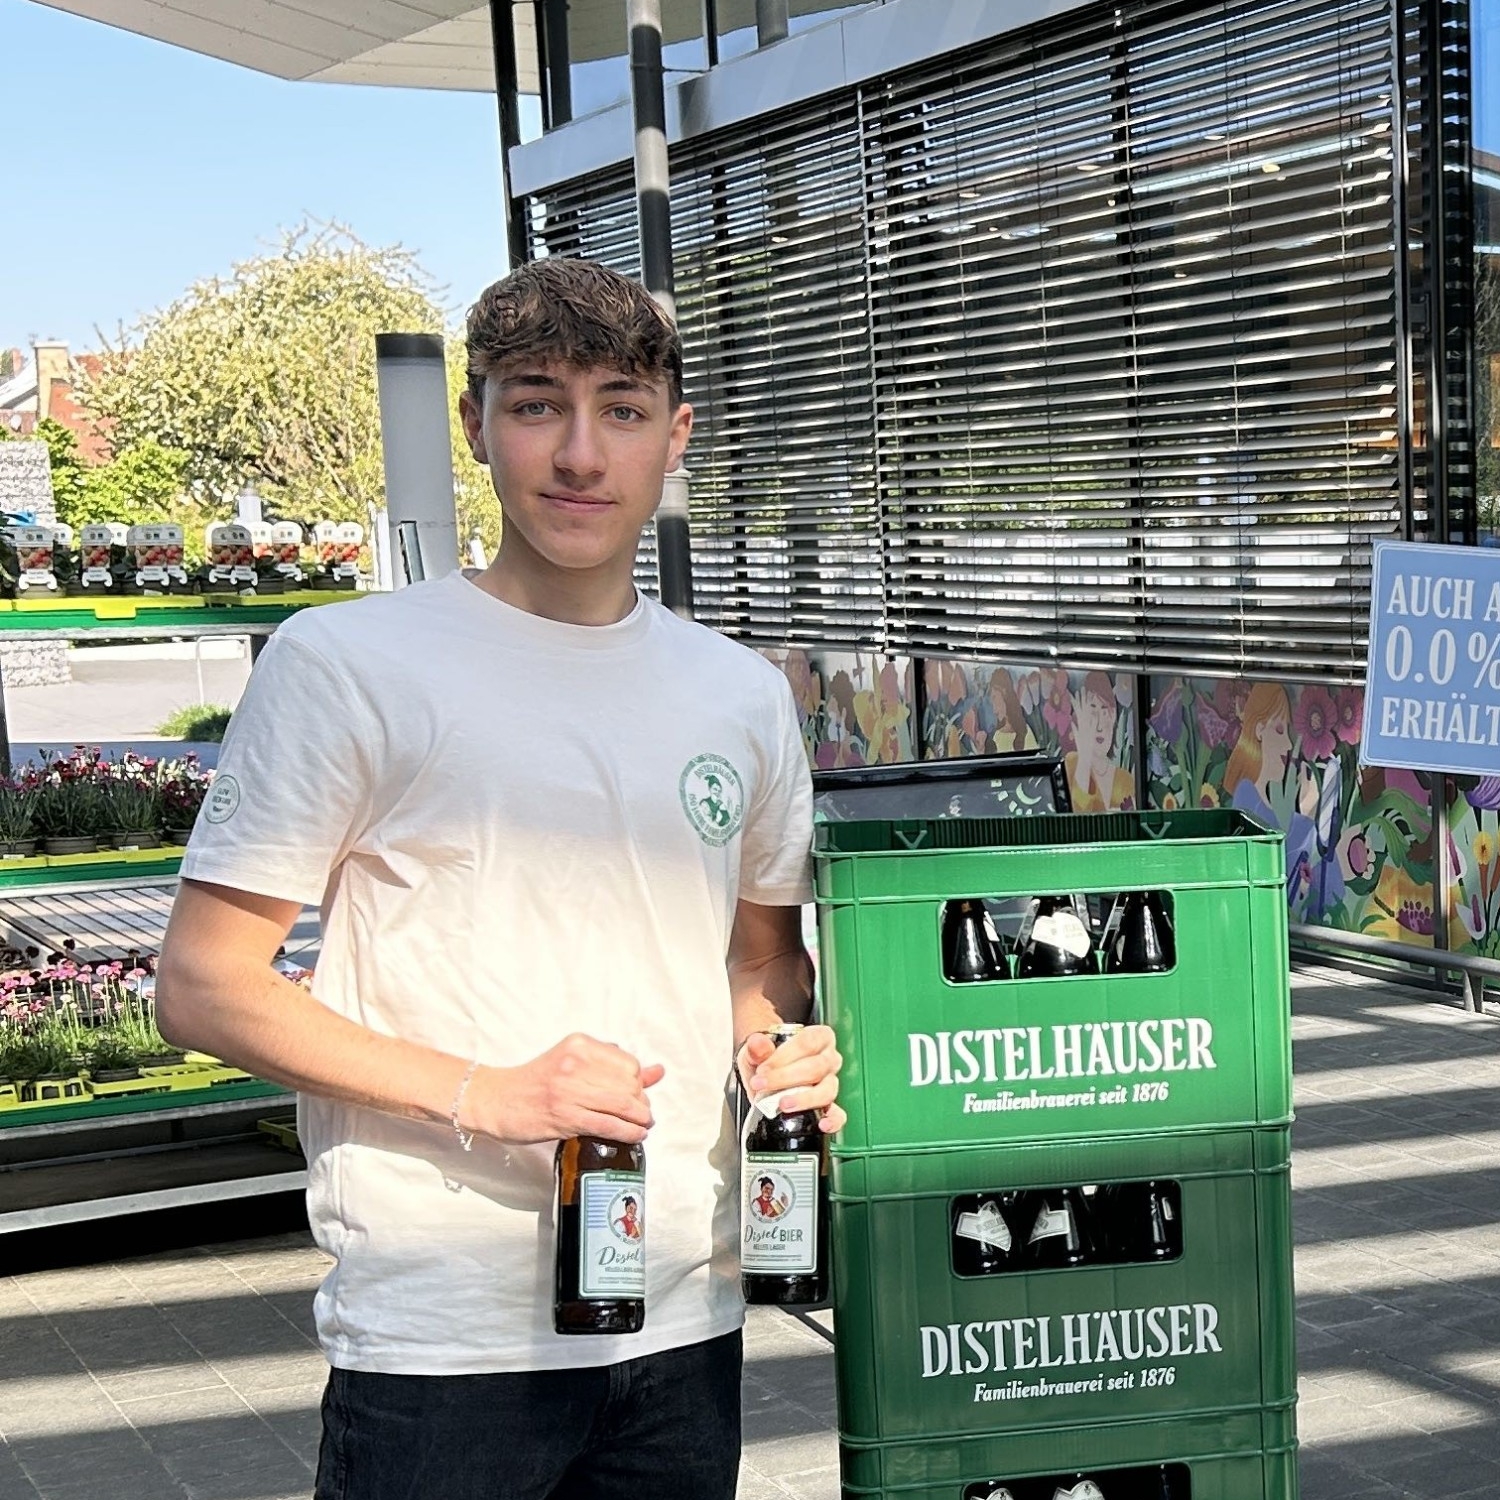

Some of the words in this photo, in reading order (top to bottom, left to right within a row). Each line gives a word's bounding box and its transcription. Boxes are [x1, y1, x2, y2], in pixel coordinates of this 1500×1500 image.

[1387, 574, 1473, 621] AUCH
[1385, 625, 1456, 685] 0.0
[908, 1018, 1217, 1087] DISTELHÄUSER
[963, 1087, 1096, 1114] Familienbrauerei
[1099, 1086, 1128, 1106] seit
[1132, 1081, 1169, 1103] 1876
[743, 1224, 779, 1243] Distel
[780, 1229, 803, 1242] BIER
[920, 1304, 1222, 1379] DISTELHÄUSER
[974, 1374, 1103, 1402] Familienbrauerei
[1107, 1371, 1135, 1391] seit
[1140, 1366, 1176, 1388] 1876
